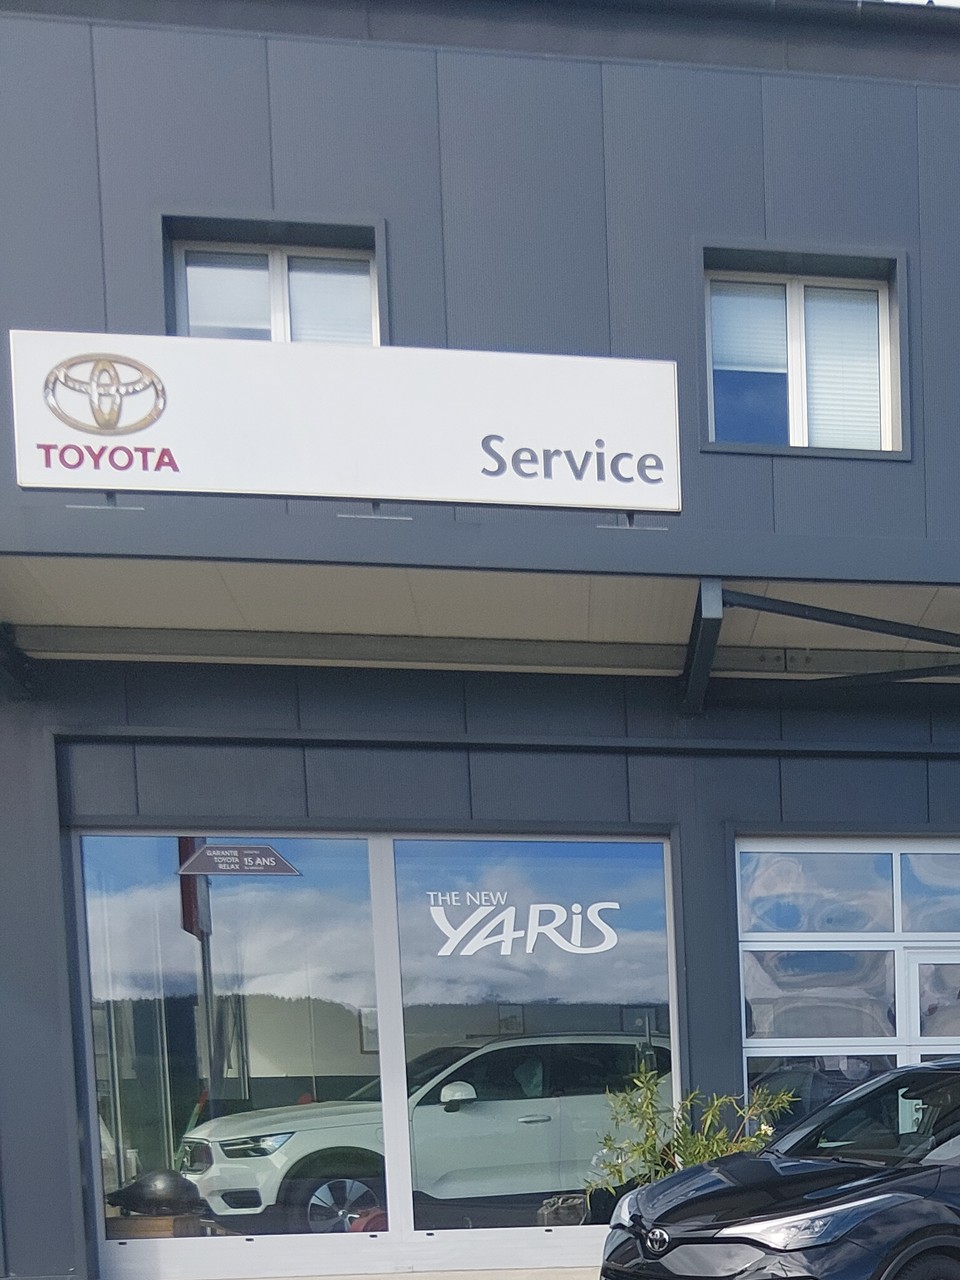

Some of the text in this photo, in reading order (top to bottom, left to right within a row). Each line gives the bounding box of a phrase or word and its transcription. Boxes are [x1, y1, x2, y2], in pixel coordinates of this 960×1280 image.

[36, 443, 180, 472] TOYOTA
[481, 434, 664, 484] Service
[256, 858, 276, 866] ANS
[426, 891, 508, 906] THE NEW
